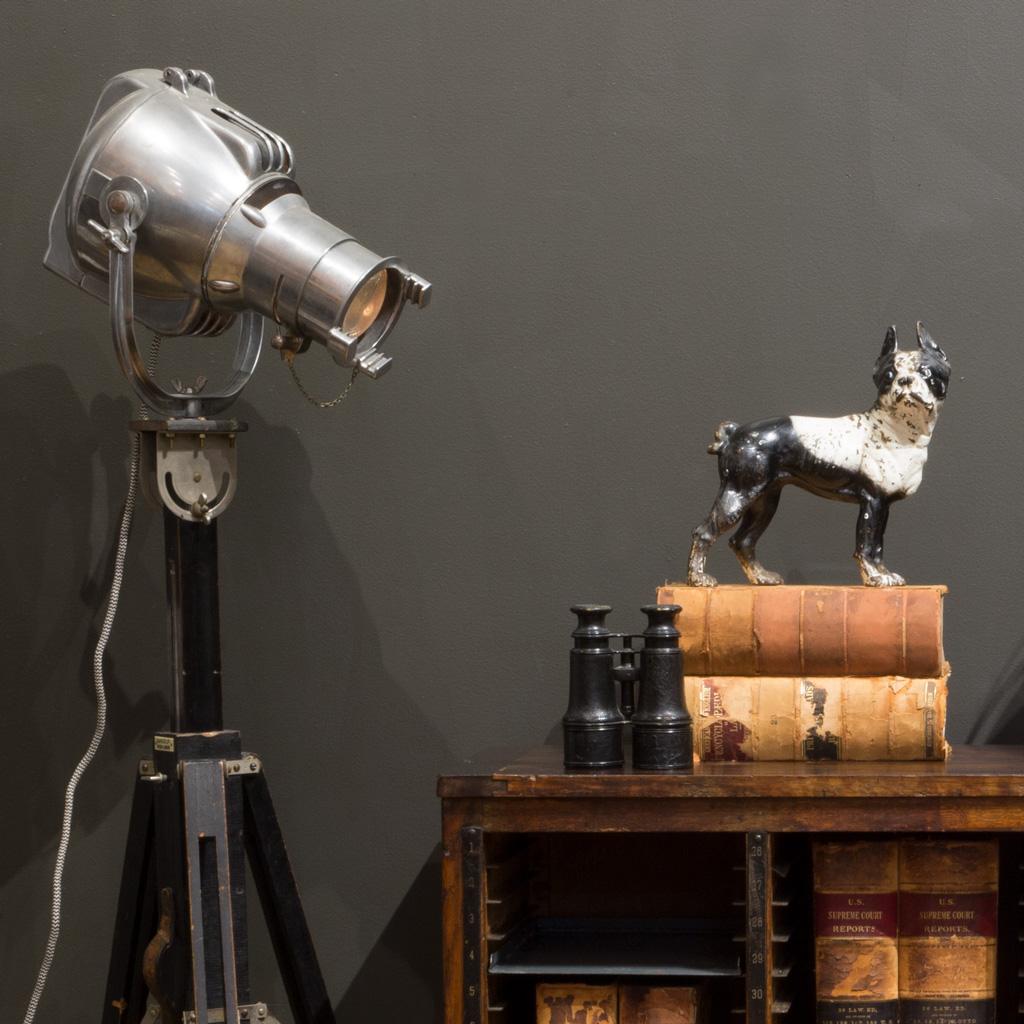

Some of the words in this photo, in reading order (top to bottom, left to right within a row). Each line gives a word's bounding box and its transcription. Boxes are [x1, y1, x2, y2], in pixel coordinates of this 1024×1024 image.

[467, 913, 475, 924] 3
[827, 911, 860, 920] SUPREME
[861, 911, 882, 920] COURT
[952, 911, 974, 920] COURT
[468, 949, 475, 961] 4
[752, 953, 763, 964] 29
[468, 985, 476, 997] 5
[752, 989, 763, 1000] 30
